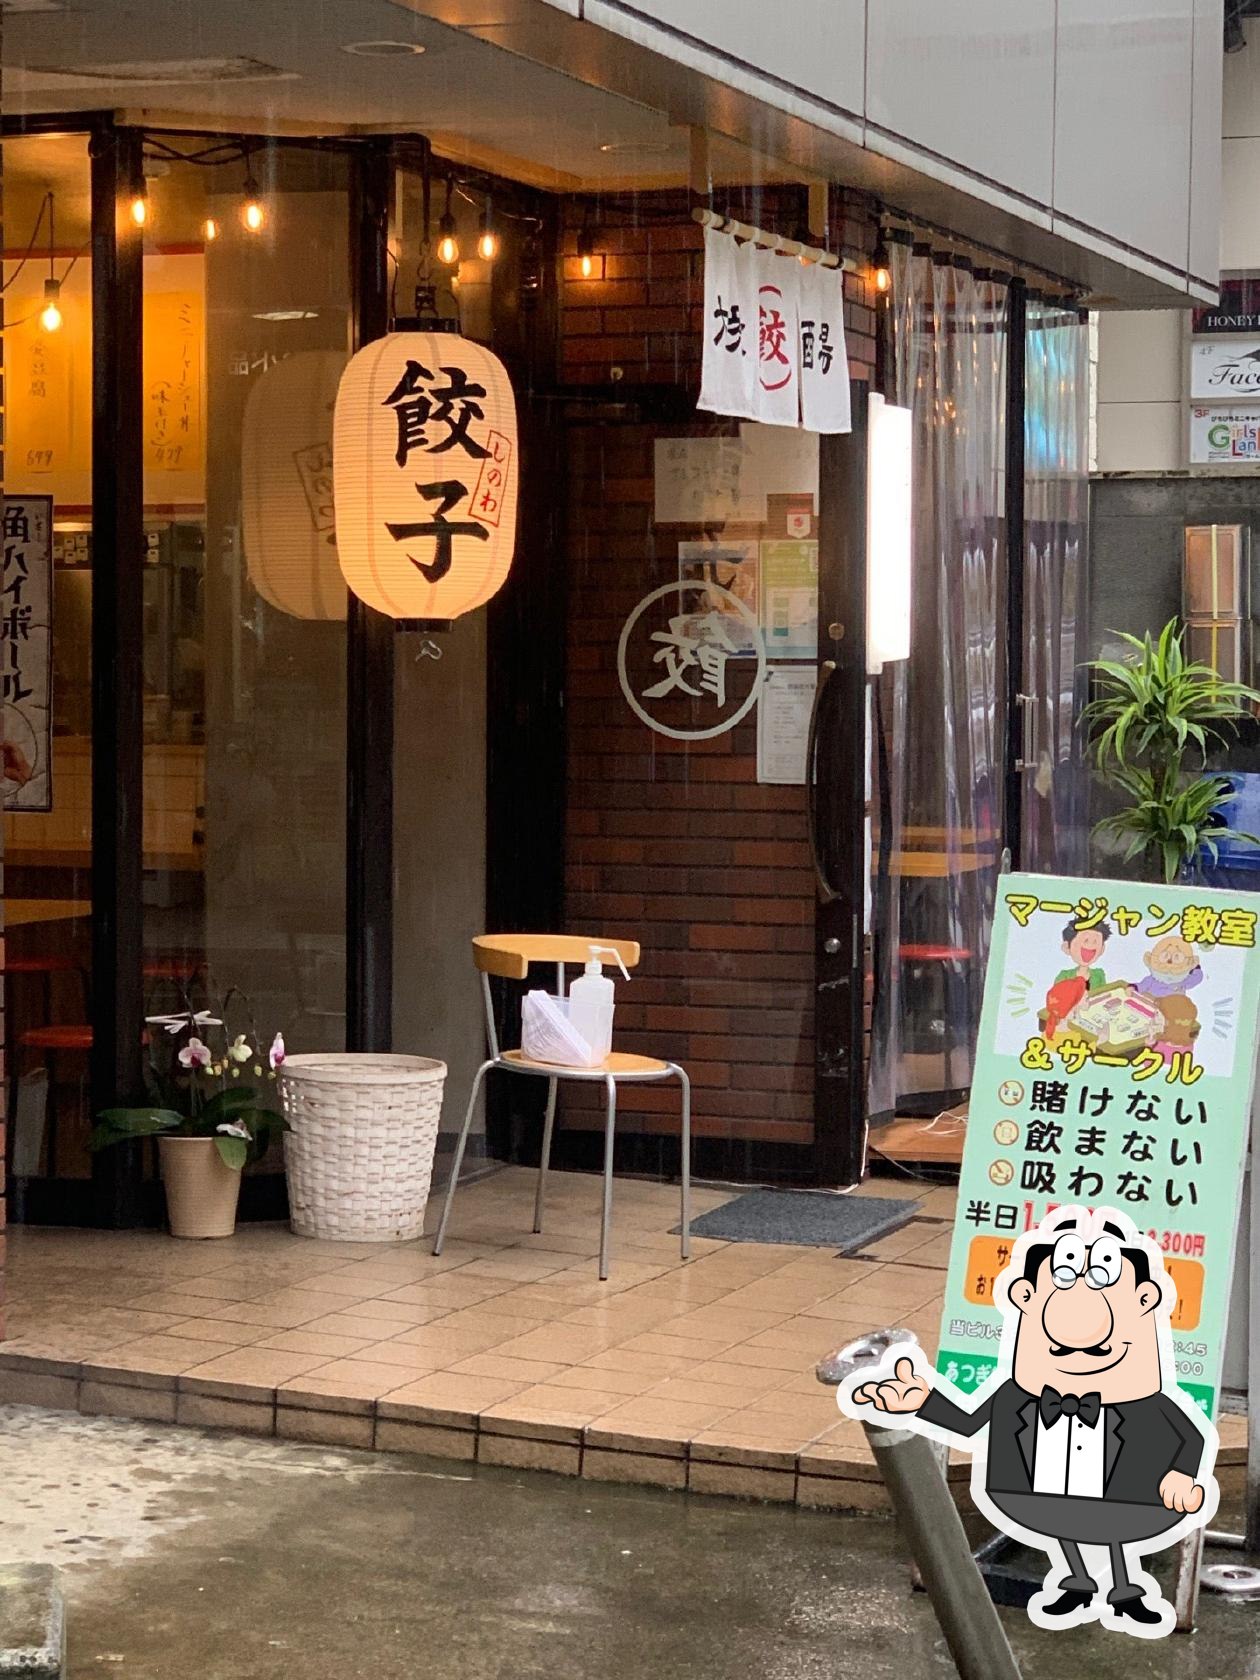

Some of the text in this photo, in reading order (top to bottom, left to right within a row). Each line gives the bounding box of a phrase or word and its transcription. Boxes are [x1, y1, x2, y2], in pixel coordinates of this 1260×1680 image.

[1207, 314, 1256, 328] HONEY
[1194, 409, 1210, 418] 3F
[381, 360, 493, 584] 餃子
[480, 441, 505, 512] しのわ
[2, 506, 33, 703] 角ハイボール
[1005, 893, 1257, 948] マージャン教室
[1020, 1038, 1204, 1086] &サークル
[1029, 1080, 1208, 1126] 賭けない
[1025, 1119, 1202, 1166] 飲まない
[1020, 1160, 1198, 1208] 吸わない
